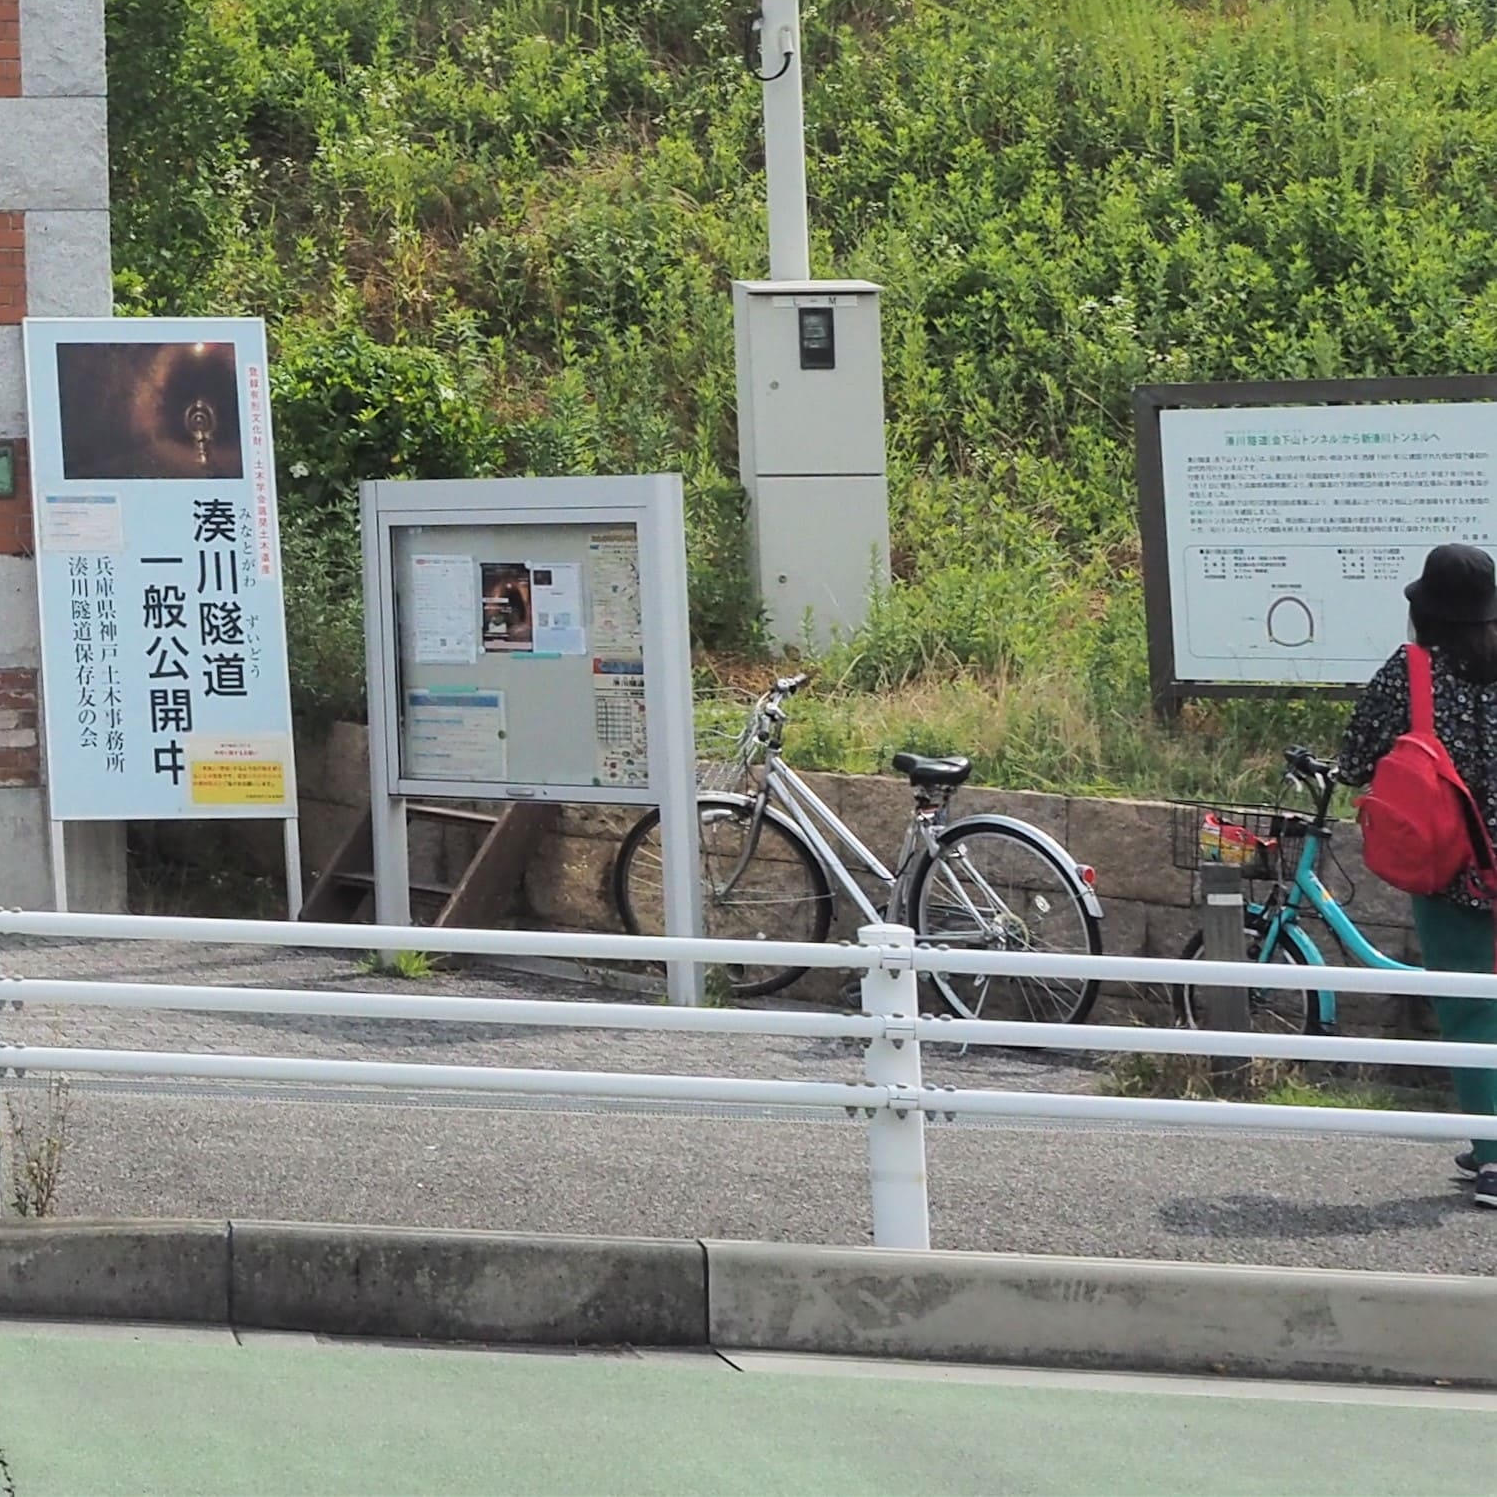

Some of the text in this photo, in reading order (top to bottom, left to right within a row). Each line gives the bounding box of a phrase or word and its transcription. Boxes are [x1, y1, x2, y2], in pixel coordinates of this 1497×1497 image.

[193, 498, 248, 698] 湊川隧道
[239, 507, 256, 588] みなとがわ
[68, 556, 98, 748] 湊川隧道保存友の会
[96, 556, 126, 773] 兵庫県神戸土木事務所
[140, 557, 193, 785] 一般公開中
[246, 615, 260, 678] ずいどう
